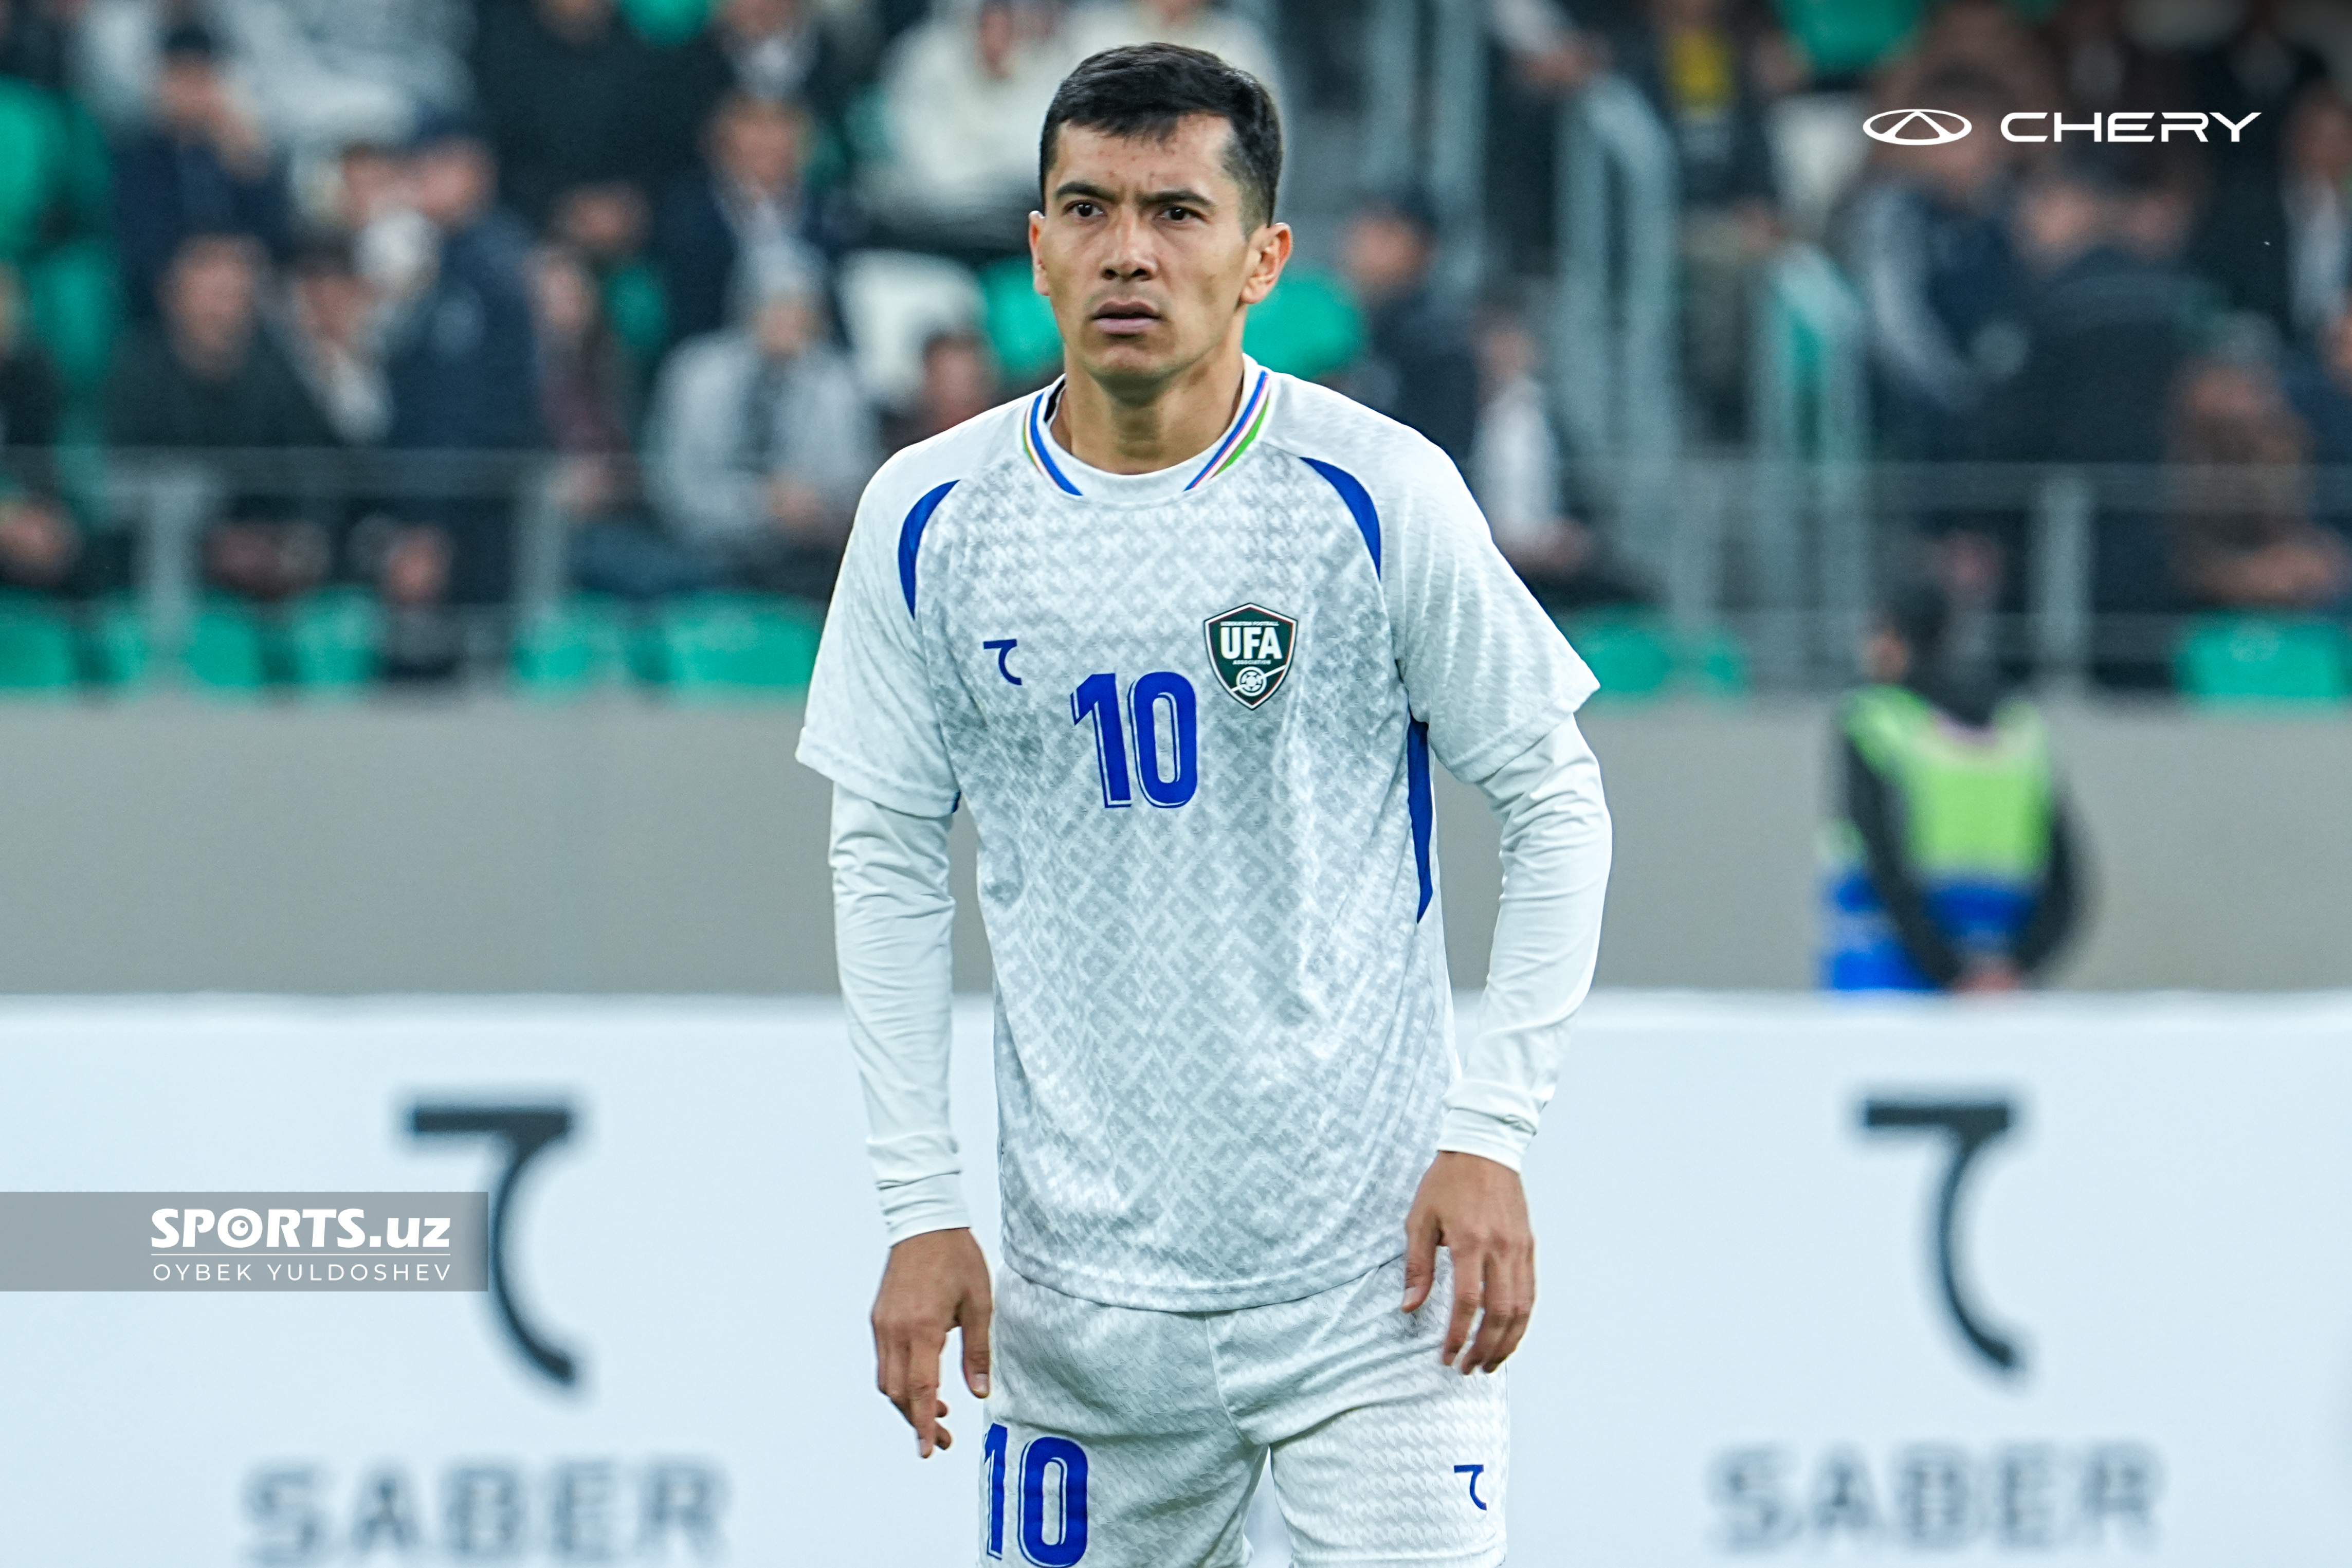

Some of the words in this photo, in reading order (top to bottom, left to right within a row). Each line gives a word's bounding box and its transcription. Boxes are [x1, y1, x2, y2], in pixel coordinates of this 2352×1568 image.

[1220, 627, 1283, 659] UFA
[1070, 671, 1197, 808] 10
[241, 1457, 733, 1562] SABER
[983, 1423, 1088, 1568] 10
[1706, 1443, 2164, 1554] SABER
